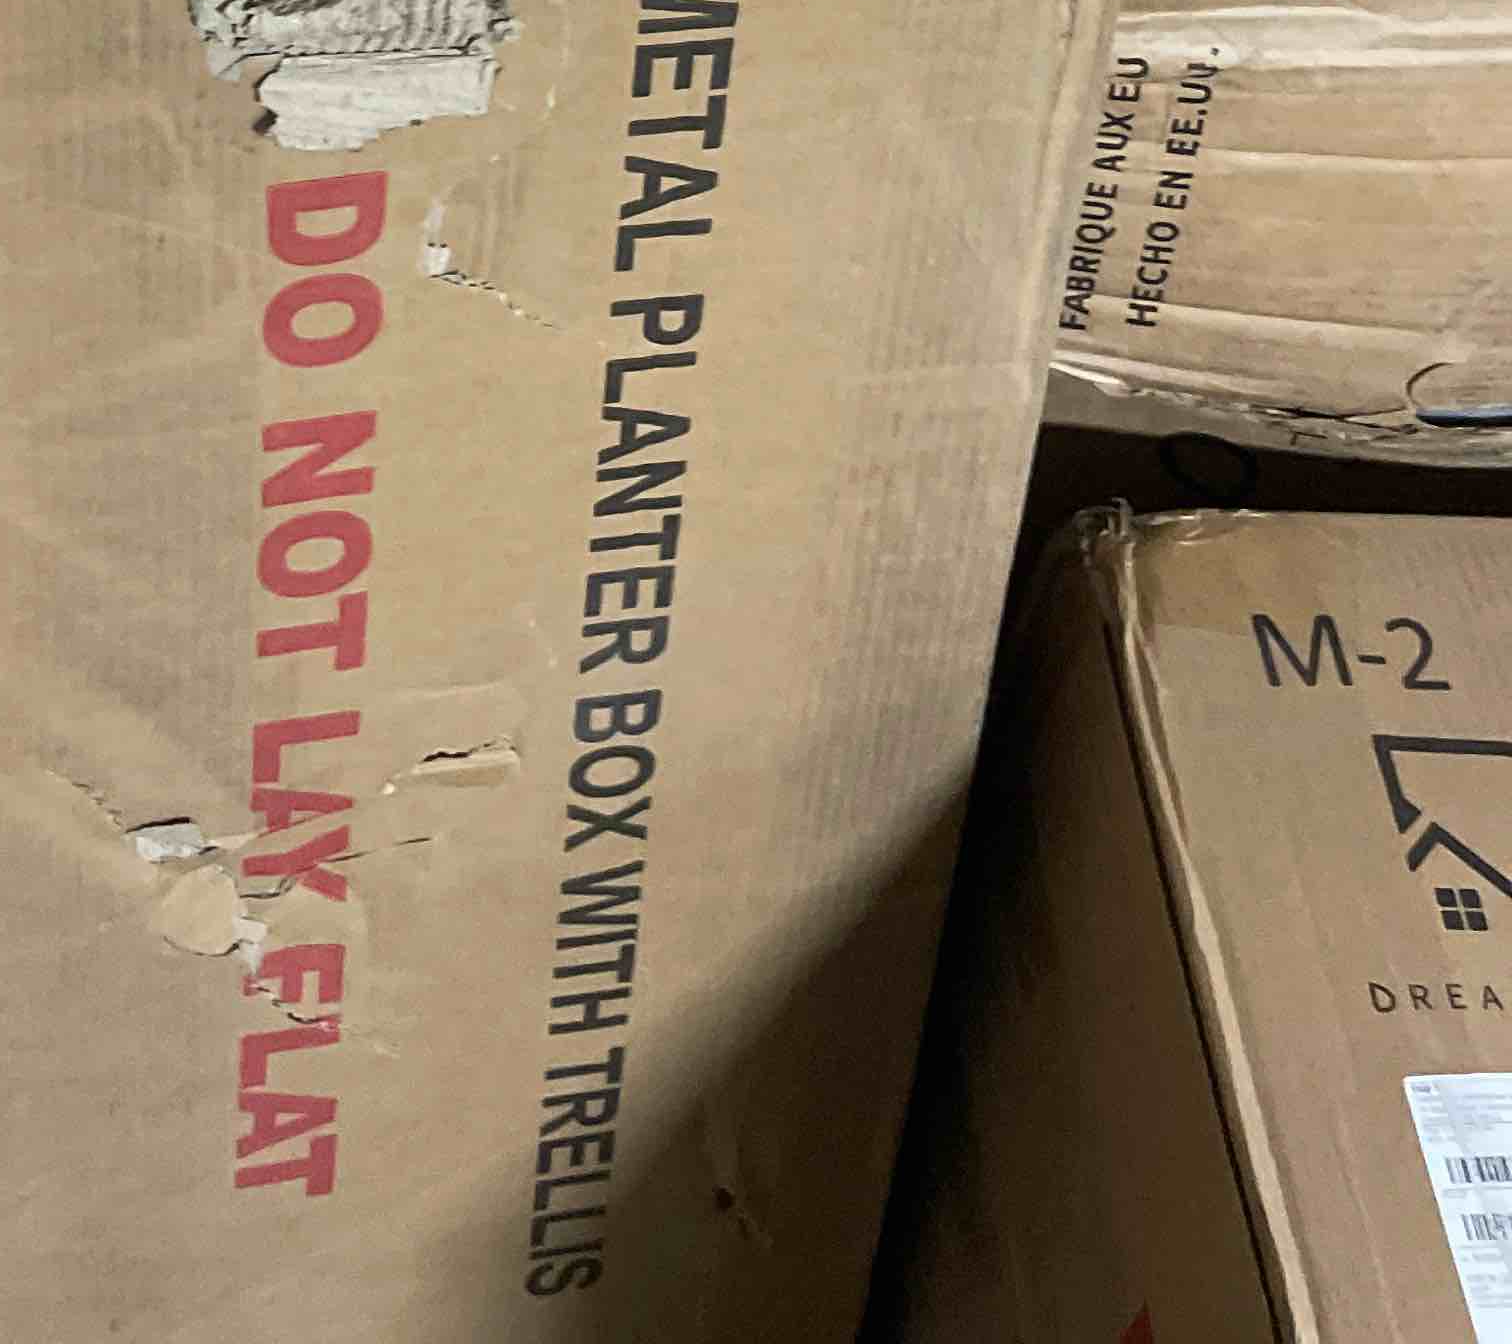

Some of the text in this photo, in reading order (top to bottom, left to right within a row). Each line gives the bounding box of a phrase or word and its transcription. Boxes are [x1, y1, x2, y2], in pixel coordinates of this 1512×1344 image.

[1058, 57, 1150, 331] FABRIQUE AUX EU
[1125, 220, 1180, 329] HECHO
[1152, 169, 1194, 210] EN
[574, 293, 706, 675] PLANTER
[233, 170, 389, 1197] DO NOT LAY FLAT
[1252, 613, 1452, 691] M-2
[563, 688, 664, 853] BOX
[548, 859, 645, 1036] WITH
[1368, 981, 1505, 1014] DREA
[523, 1045, 625, 1298] TRELLIS
